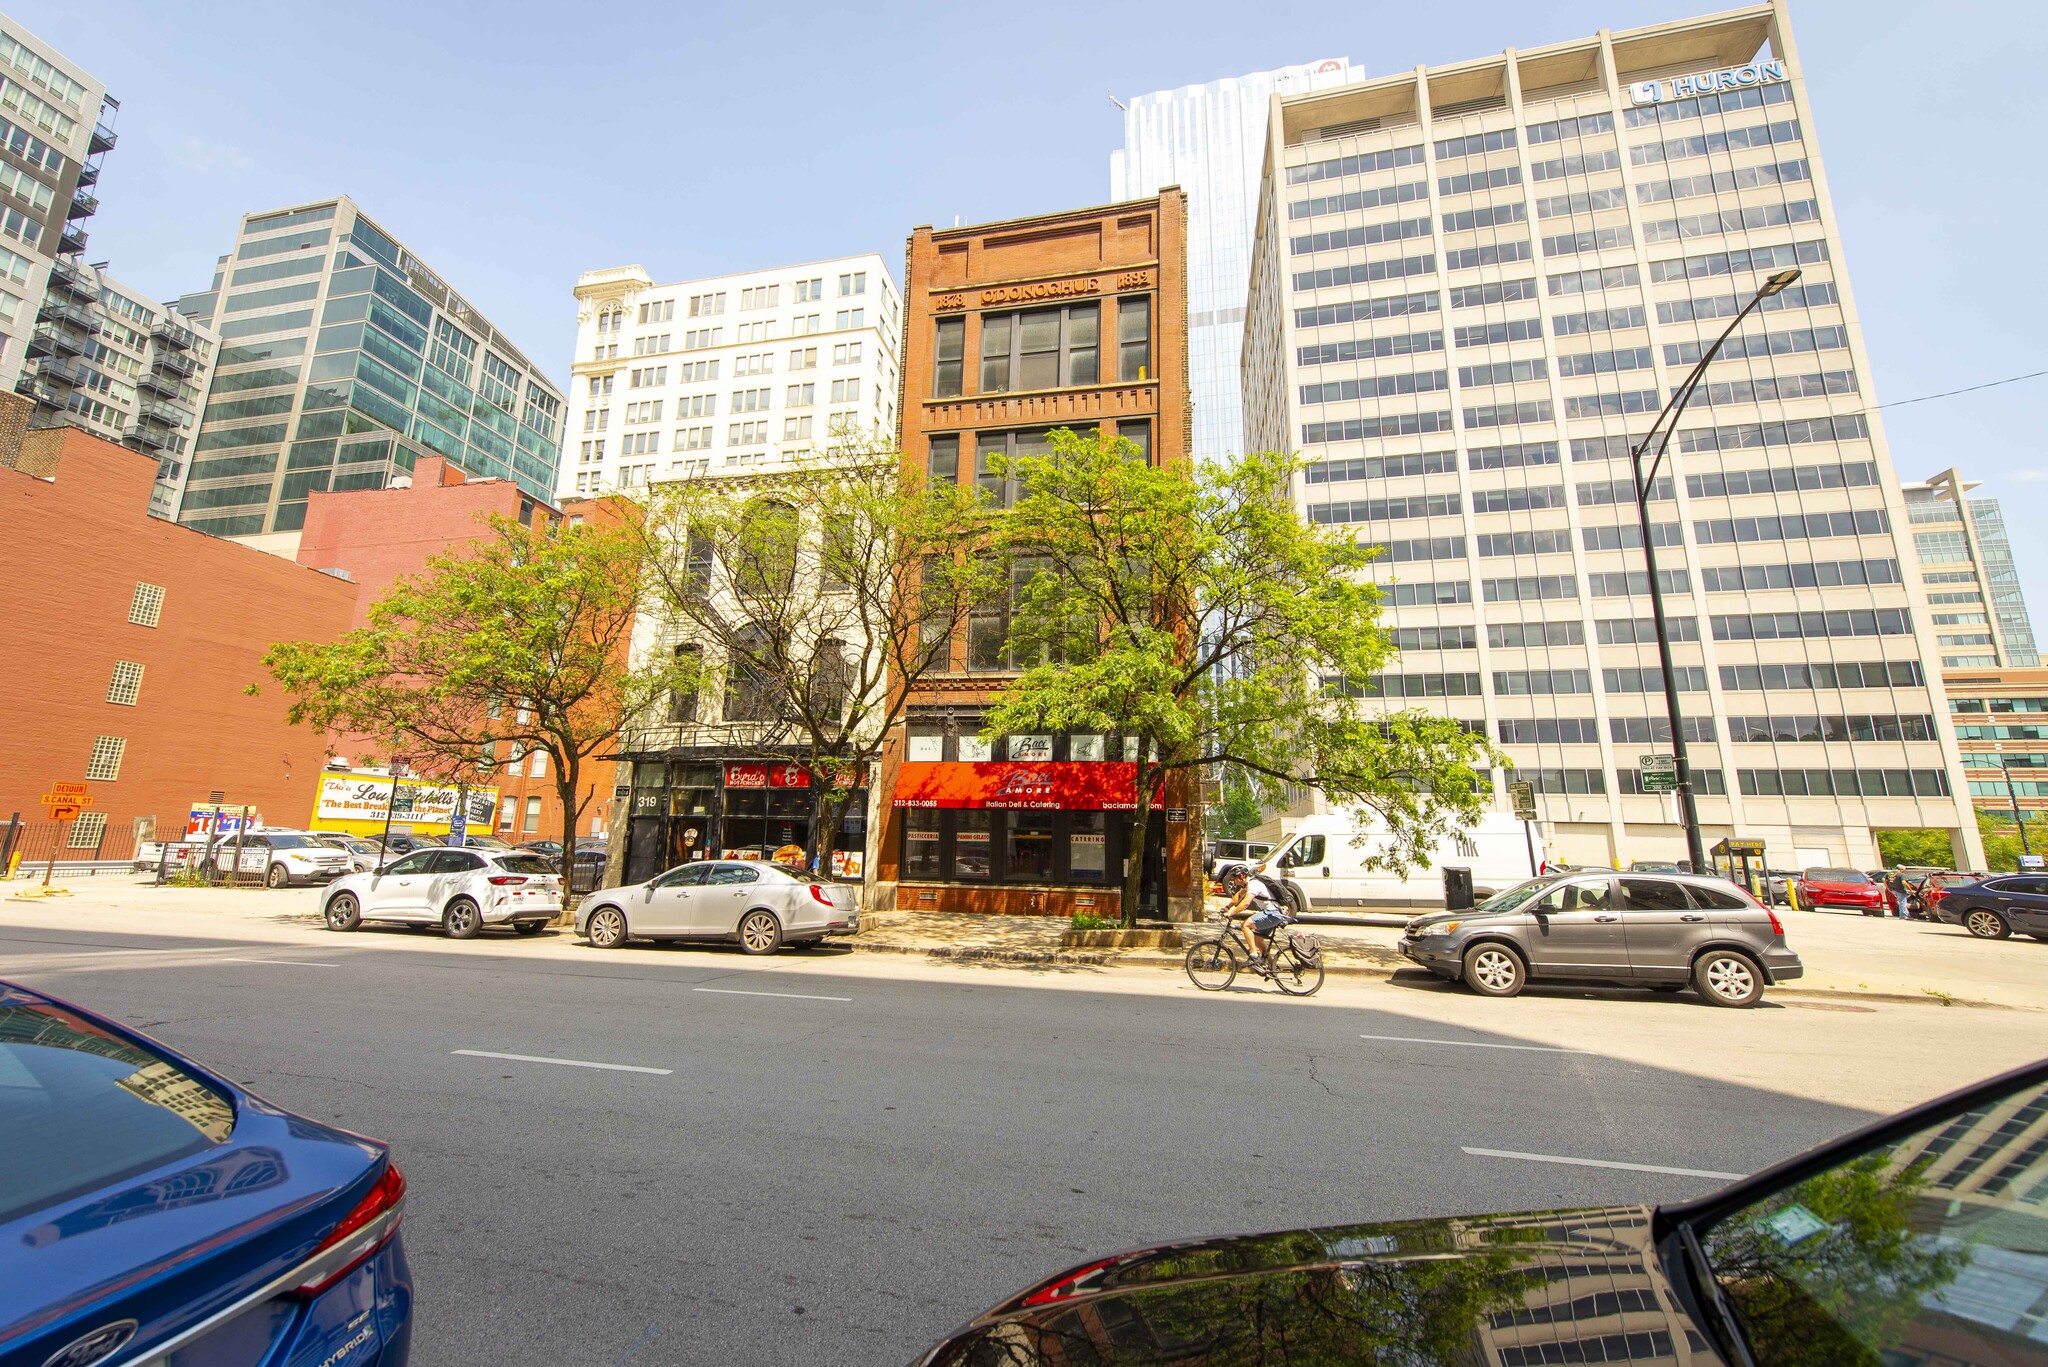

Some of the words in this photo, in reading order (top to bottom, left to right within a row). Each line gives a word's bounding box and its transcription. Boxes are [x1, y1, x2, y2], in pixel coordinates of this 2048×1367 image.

[1674, 62, 1782, 97] HURON
[935, 294, 966, 312] 1878
[1117, 271, 1151, 289] 1892
[729, 766, 765, 783] Byrd's
[56, 785, 84, 793] DETOUR
[325, 782, 344, 791] This
[352, 784, 388, 801] Lou
[343, 800, 362, 809] Best
[638, 796, 657, 807] 319
[1030, 801, 1060, 809] Catering
[907, 832, 939, 840] PASTICCERIA
